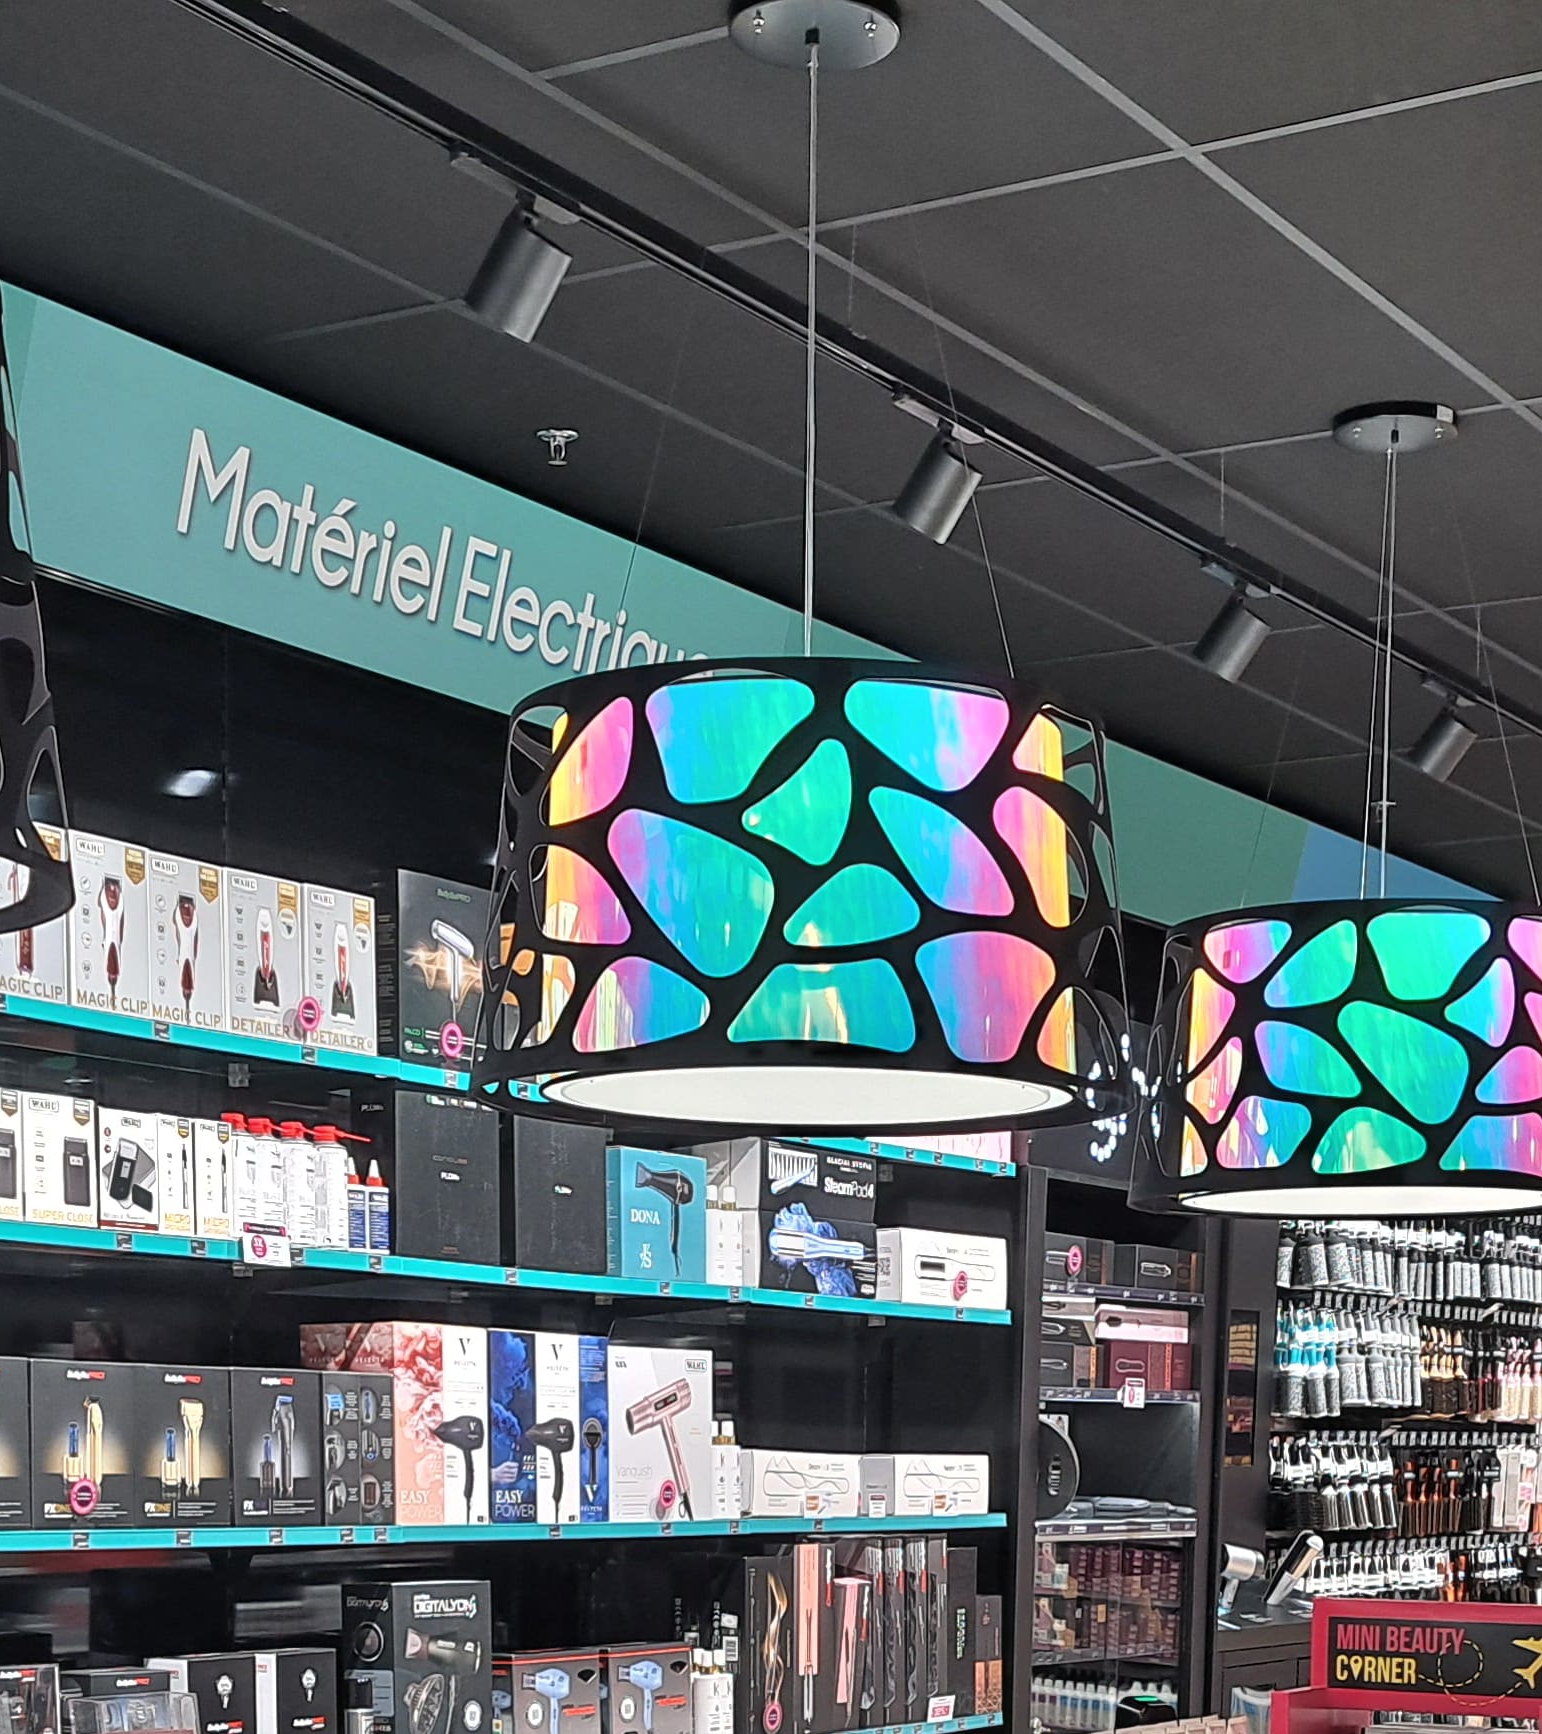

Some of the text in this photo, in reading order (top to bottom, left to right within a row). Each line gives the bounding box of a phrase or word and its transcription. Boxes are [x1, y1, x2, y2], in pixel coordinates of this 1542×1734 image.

[176, 427, 709, 674] Matériel Electriq
[34, 981, 64, 999] CLIP
[77, 989, 148, 1014] MAGIC CLIP
[152, 1004, 222, 1027] MAGIC CLIP
[232, 1017, 290, 1036] DETAILER
[313, 1032, 365, 1049] DETAILER
[32, 1099, 57, 1110] WAHL
[32, 1209, 60, 1221] SUPER
[631, 1208, 661, 1225] DONA
[400, 1489, 429, 1503] EASY
[496, 1490, 523, 1504] EASY
[401, 1504, 442, 1518] POWER
[495, 1503, 535, 1518] POWER
[1337, 1623, 1465, 1655] MINI BEAUTY
